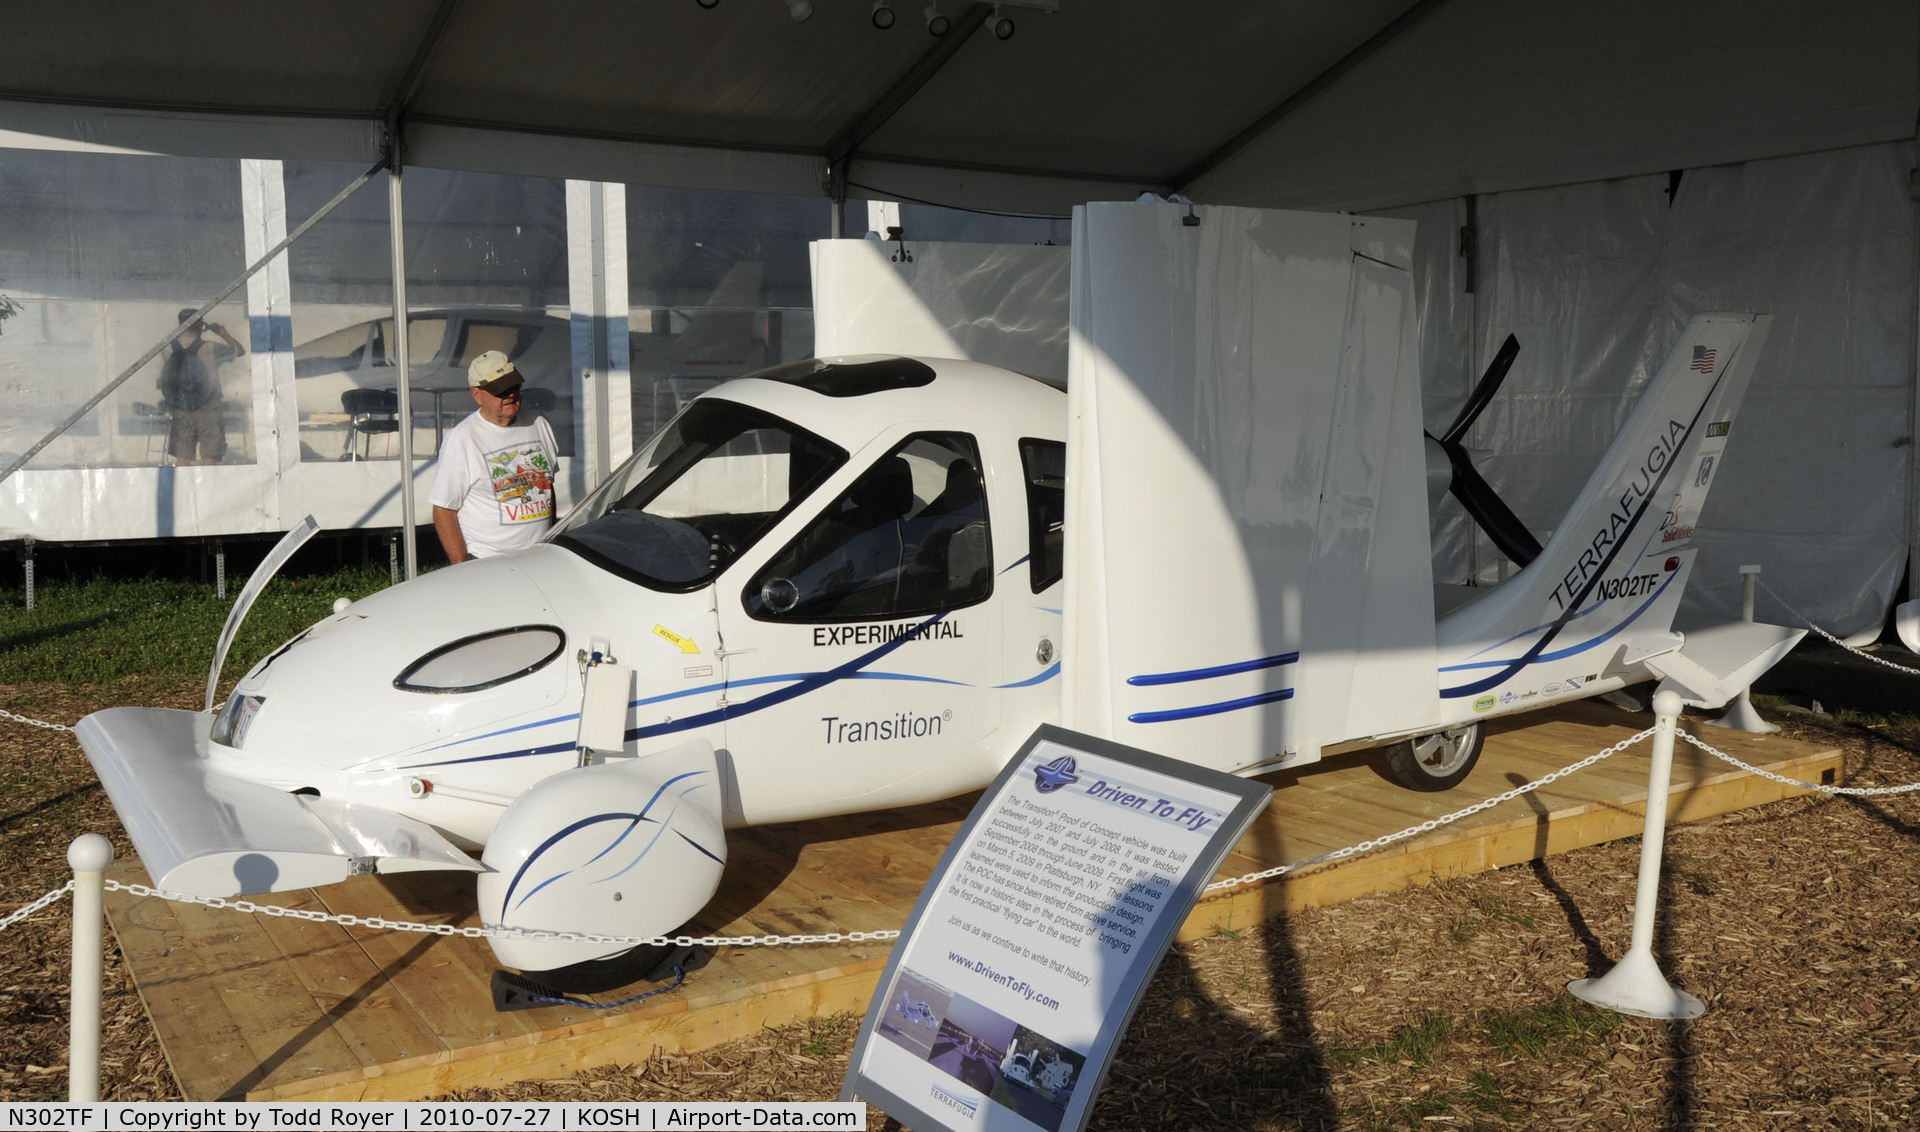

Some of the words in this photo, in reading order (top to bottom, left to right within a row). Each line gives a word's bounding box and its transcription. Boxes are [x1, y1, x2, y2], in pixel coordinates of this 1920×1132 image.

[1549, 420, 1686, 611] TERRAFUGIA
[1597, 573, 1659, 602] N302TF
[660, 629, 680, 643] RESCUE
[813, 620, 964, 647] EXPERIMENTAL
[1007, 796, 1020, 807] The
[1059, 813, 1079, 826] Proof
[1080, 821, 1090, 829] of
[1089, 822, 1121, 840] Concept
[1122, 835, 1149, 850] vehicle
[1151, 845, 1166, 856] was
[1169, 849, 1188, 863] built
[1086, 780, 1148, 810] Driven
[1149, 798, 1175, 818] To
[984, 828, 1020, 847] September
[1019, 841, 1038, 853] 2008
[1037, 846, 1064, 864] through
[1064, 857, 1083, 870] June
[1083, 864, 1104, 878] 2009.
[1107, 872, 1128, 886] First
[1126, 879, 1146, 893] flight
[1145, 888, 1162, 900] was
[991, 818, 1032, 837] successfully
[1034, 833, 1044, 841] on
[1046, 836, 1059, 847] the
[1061, 843, 1089, 858] ground
[1090, 853, 1106, 864] and
[1108, 857, 1116, 867] in
[1119, 862, 1133, 873] the
[1136, 869, 1148, 878] air
[1150, 873, 1170, 887] from
[999, 806, 1027, 822] between
[1029, 816, 1044, 829] July
[1046, 822, 1065, 834] 2007
[1066, 830, 1081, 841] and
[1083, 834, 1099, 848] July
[1100, 842, 1121, 855] 2008.
[1125, 850, 1132, 858] It
[1134, 854, 1150, 865] was
[1153, 859, 1180, 875] tested
[963, 861, 976, 873] The
[975, 867, 994, 880] POC
[992, 872, 1006, 886] has
[1006, 879, 1024, 892] since
[1023, 887, 1042, 899] been
[1043, 894, 1065, 910] retired
[1065, 903, 1084, 918] from
[1083, 911, 1106, 926] active
[1107, 920, 1137, 938] service.
[969, 850, 994, 866] learned
[995, 861, 1012, 873] were
[1012, 866, 1030, 879] used
[1030, 874, 1038, 883] to
[1039, 875, 1066, 893] inform
[1062, 884, 1075, 897] the
[1075, 892, 1116, 913] production
[1116, 907, 1145, 926] design.
[977, 840, 986, 848] on
[986, 842, 1007, 857] March
[1016, 853, 1036, 866] 2009
[1035, 859, 1043, 869] in
[1043, 863, 1085, 887] Plattsburgh,
[1107, 887, 1122, 900] The
[1123, 893, 1154, 912] lessons
[949, 885, 959, 896] the
[960, 889, 973, 901] first
[972, 895, 1002, 914] practical
[1038, 922, 1046, 933] to
[1046, 926, 1059, 938] the
[1060, 933, 1081, 948] world.
[955, 873, 962, 882] It
[962, 875, 968, 884] is
[969, 879, 984, 891] now
[990, 887, 1015, 905] historic
[1016, 898, 1032, 912] step
[1033, 905, 1040, 915] in
[1041, 908, 1054, 920] the
[1054, 914, 1084, 933] process
[1086, 926, 1096, 937] of
[1099, 932, 1131, 954] bringing
[948, 915, 962, 929] Join
[962, 920, 972, 932] us
[971, 926, 982, 936] as
[981, 930, 992, 941] we
[992, 934, 1022, 957] continue
[1022, 947, 1030, 957] to
[1030, 950, 1049, 967] write
[1048, 959, 1065, 974] that
[1064, 967, 1092, 986] history.
[948, 951, 1060, 1011] www.DrivenToFly.com
[930, 1087, 975, 1120] TERRAFUGIA
